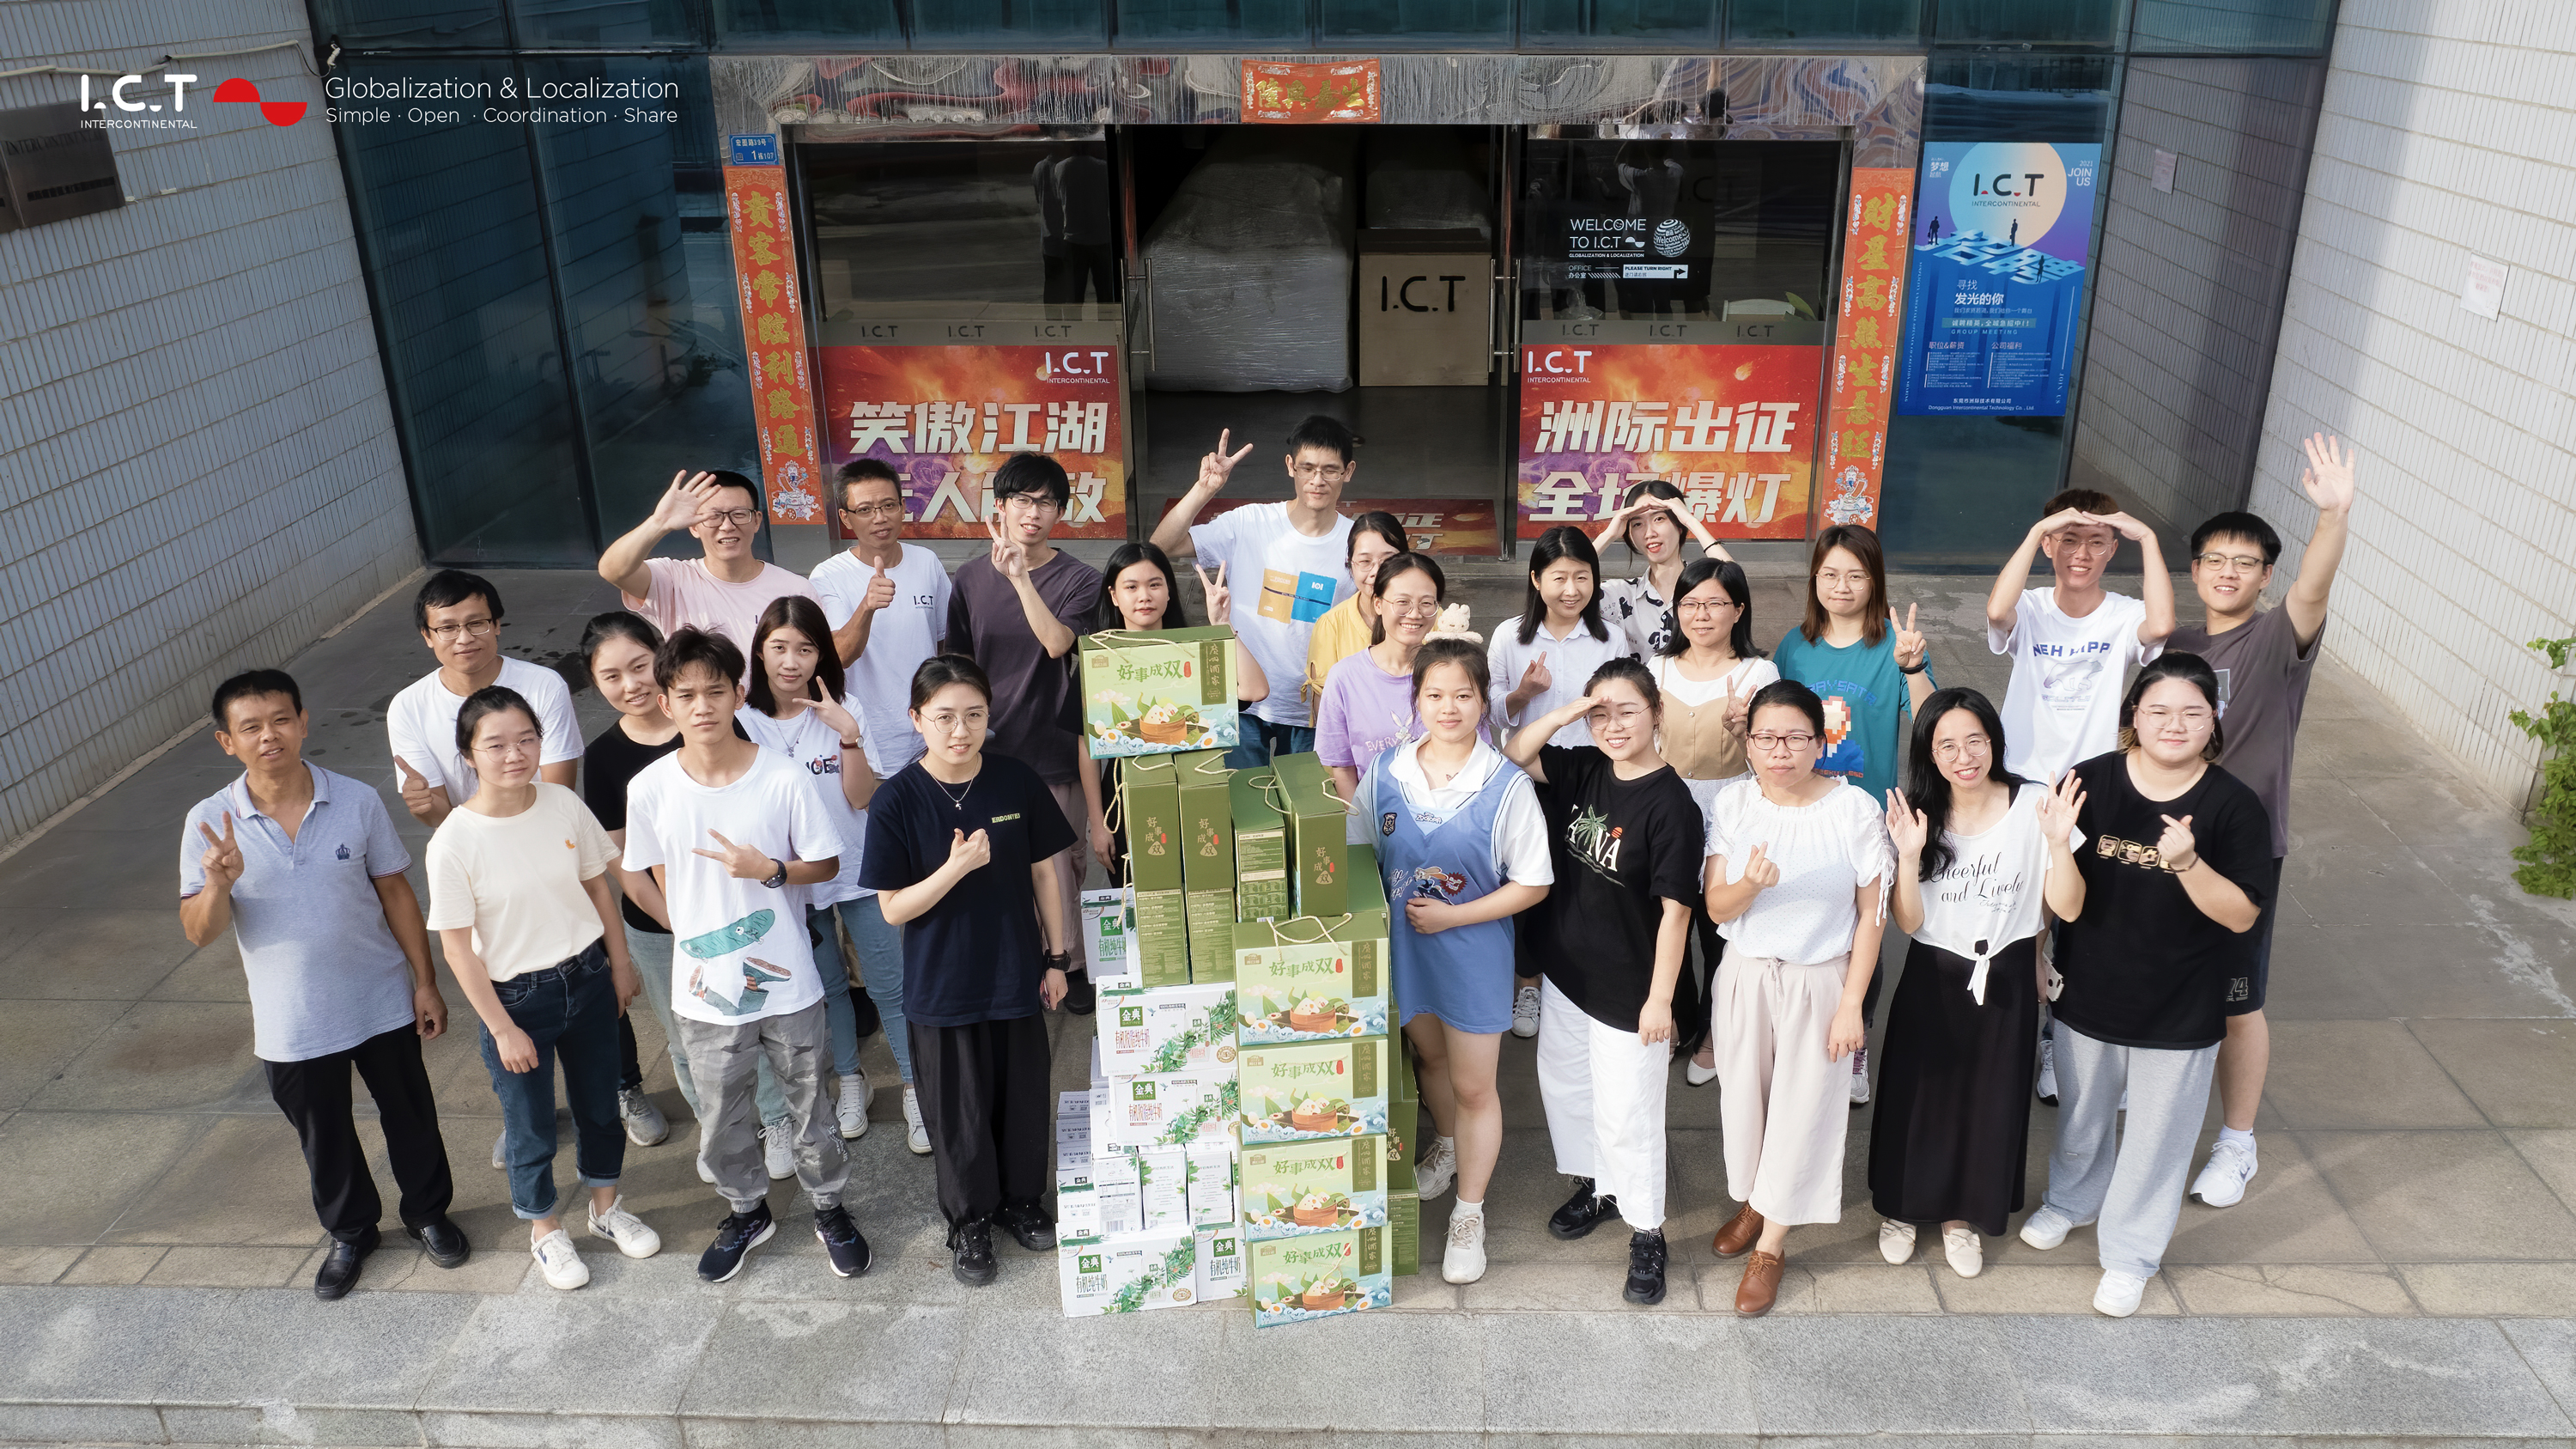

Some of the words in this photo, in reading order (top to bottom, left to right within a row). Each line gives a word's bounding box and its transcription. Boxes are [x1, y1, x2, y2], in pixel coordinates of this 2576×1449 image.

[1930, 161, 1949, 172] 梦想
[2068, 167, 2093, 177] JOIN
[1973, 173, 2044, 197] I.C.T
[2076, 177, 2091, 186] US
[1570, 218, 1647, 231] WELCOME
[1570, 236, 1589, 248] TO
[1594, 236, 1621, 248] I.C.T
[1381, 275, 1467, 314] I.C.T
[1956, 279, 1978, 291] 寻找
[1954, 292, 2005, 306] 发光的你
[1045, 351, 1109, 374] I.C.T
[1528, 350, 1592, 374] I.C.T
[849, 400, 1109, 454] 笑傲江湖
[1534, 399, 1801, 454] 洲际出征
[913, 594, 933, 605] I.C.T
[1116, 659, 1184, 683] 好事成双
[1941, 880, 1971, 904] and
[1268, 956, 1335, 978] 好事成双
[1121, 1008, 1141, 1021] 金典
[1271, 1060, 1336, 1081] 好事成双
[1134, 1082, 1154, 1095] 金典
[1273, 1155, 1336, 1176] 好事成双
[1215, 1239, 1234, 1252] 金典
[1283, 1242, 1342, 1265] 好事成双
[1080, 1256, 1100, 1269] 金典
[1209, 1256, 1242, 1276] 有机纯牛奶
